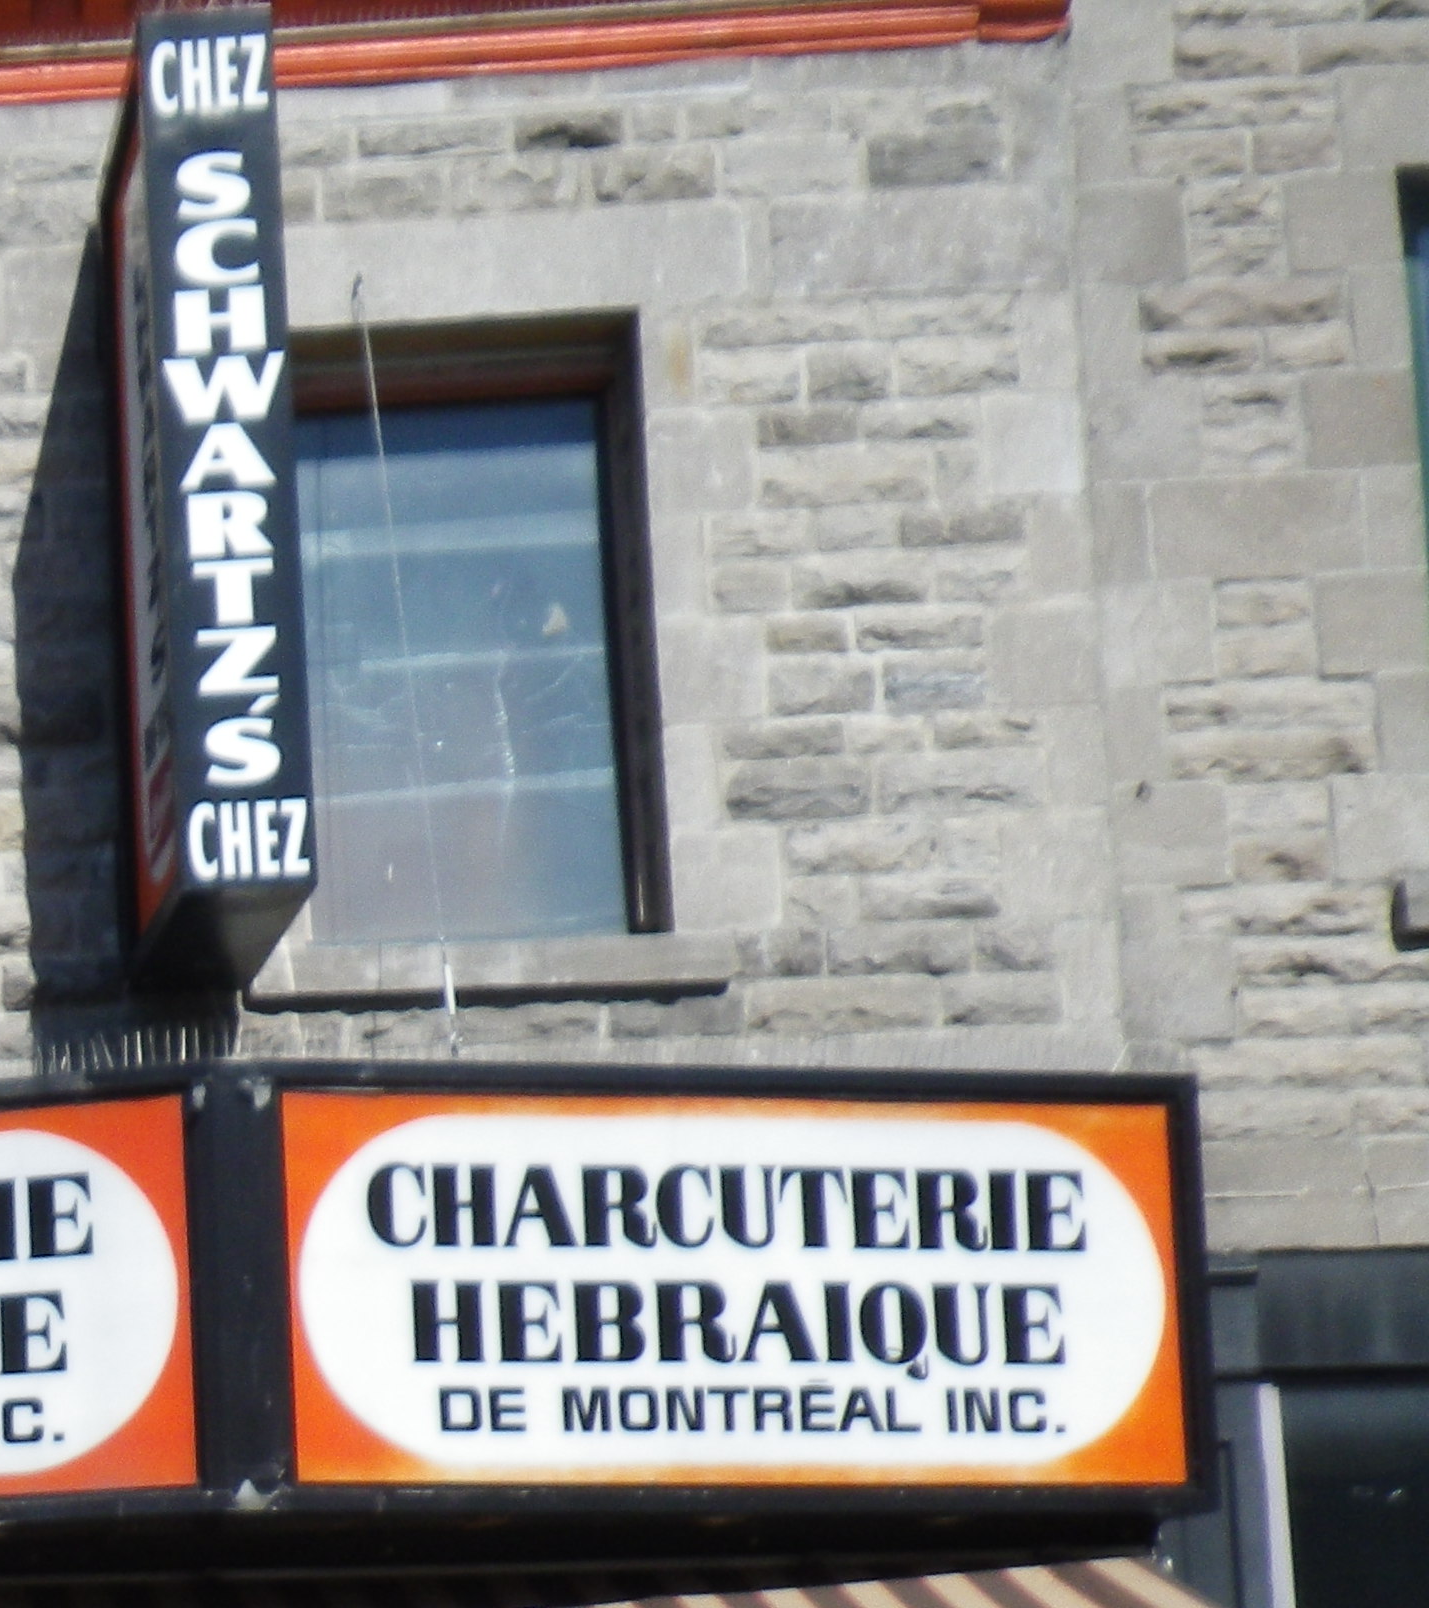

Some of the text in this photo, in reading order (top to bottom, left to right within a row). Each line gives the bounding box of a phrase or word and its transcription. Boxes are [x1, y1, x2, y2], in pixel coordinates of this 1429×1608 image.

[149, 32, 269, 117] CHEZ
[162, 151, 284, 788] SCHWARTZ'S
[188, 798, 310, 881] CHEZ
[366, 1163, 1087, 1252] CHARCUTERIE
[411, 1280, 1065, 1379] HEBRAIQUE
[439, 1387, 525, 1433] DE
[947, 1387, 1066, 1434] INC.
